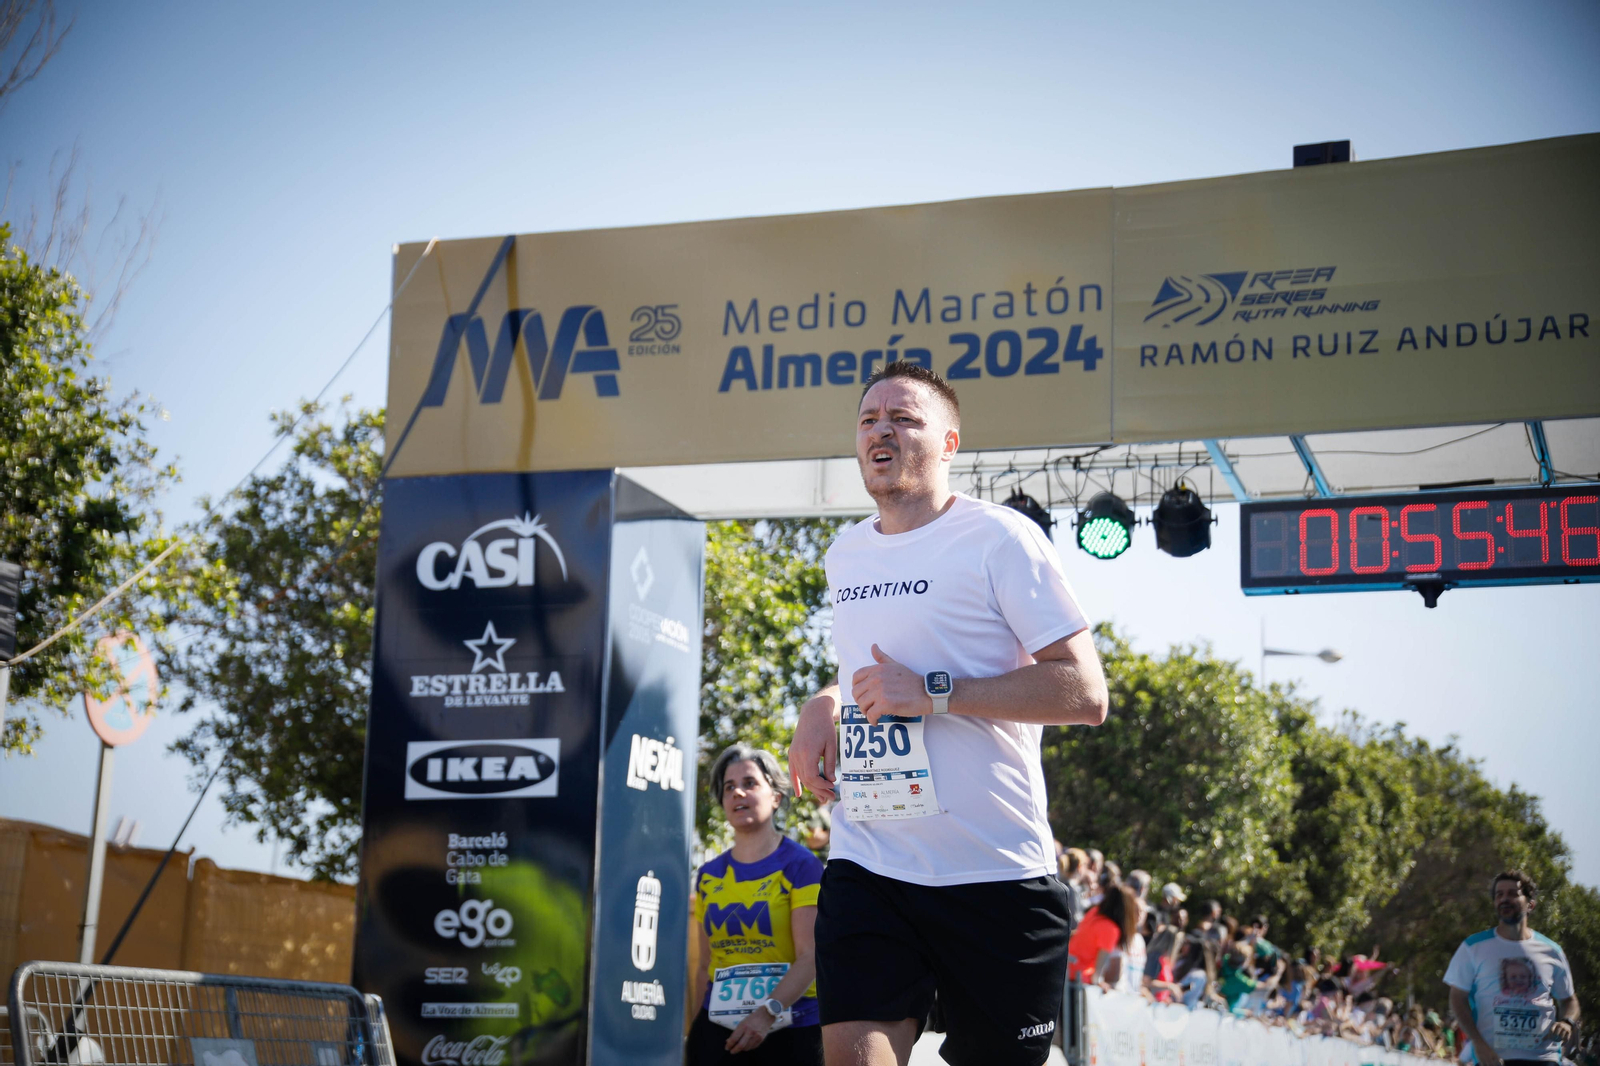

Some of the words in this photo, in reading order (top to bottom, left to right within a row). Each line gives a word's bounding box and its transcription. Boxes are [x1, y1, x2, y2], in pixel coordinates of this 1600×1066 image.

[1248, 266, 1337, 290] RFEA
[722, 292, 867, 336] Medio
[891, 276, 1103, 325] Maratón
[1239, 288, 1328, 306] SERIES
[629, 304, 682, 342] 25
[1232, 307, 1288, 323] RUTA
[1293, 300, 1381, 318] RUNNING
[627, 341, 681, 356] EDICIÓN
[1139, 333, 1275, 367] RAMÓN
[1291, 330, 1380, 359] RUIZ
[1396, 313, 1591, 352] ANDÚJAR
[946, 324, 1103, 380] 2024
[416, 537, 536, 591] CASI
[409, 671, 566, 697] ESTRELLA
[444, 695, 463, 708] DE
[465, 694, 530, 707] LEVANTE
[844, 723, 912, 759] 5250
[426, 756, 541, 782] IKEA
[447, 832, 508, 849] Barceló
[446, 850, 486, 867] Cabo
[488, 850, 509, 867] de
[446, 868, 482, 885] Gata
[434, 899, 513, 948] ego
[424, 967, 469, 984] SER
[422, 1005, 436, 1015] La
[438, 1005, 457, 1015] Voz
[459, 1005, 471, 1015] de
[473, 1004, 515, 1015] Almería
[1500, 1014, 1537, 1029] 5370
